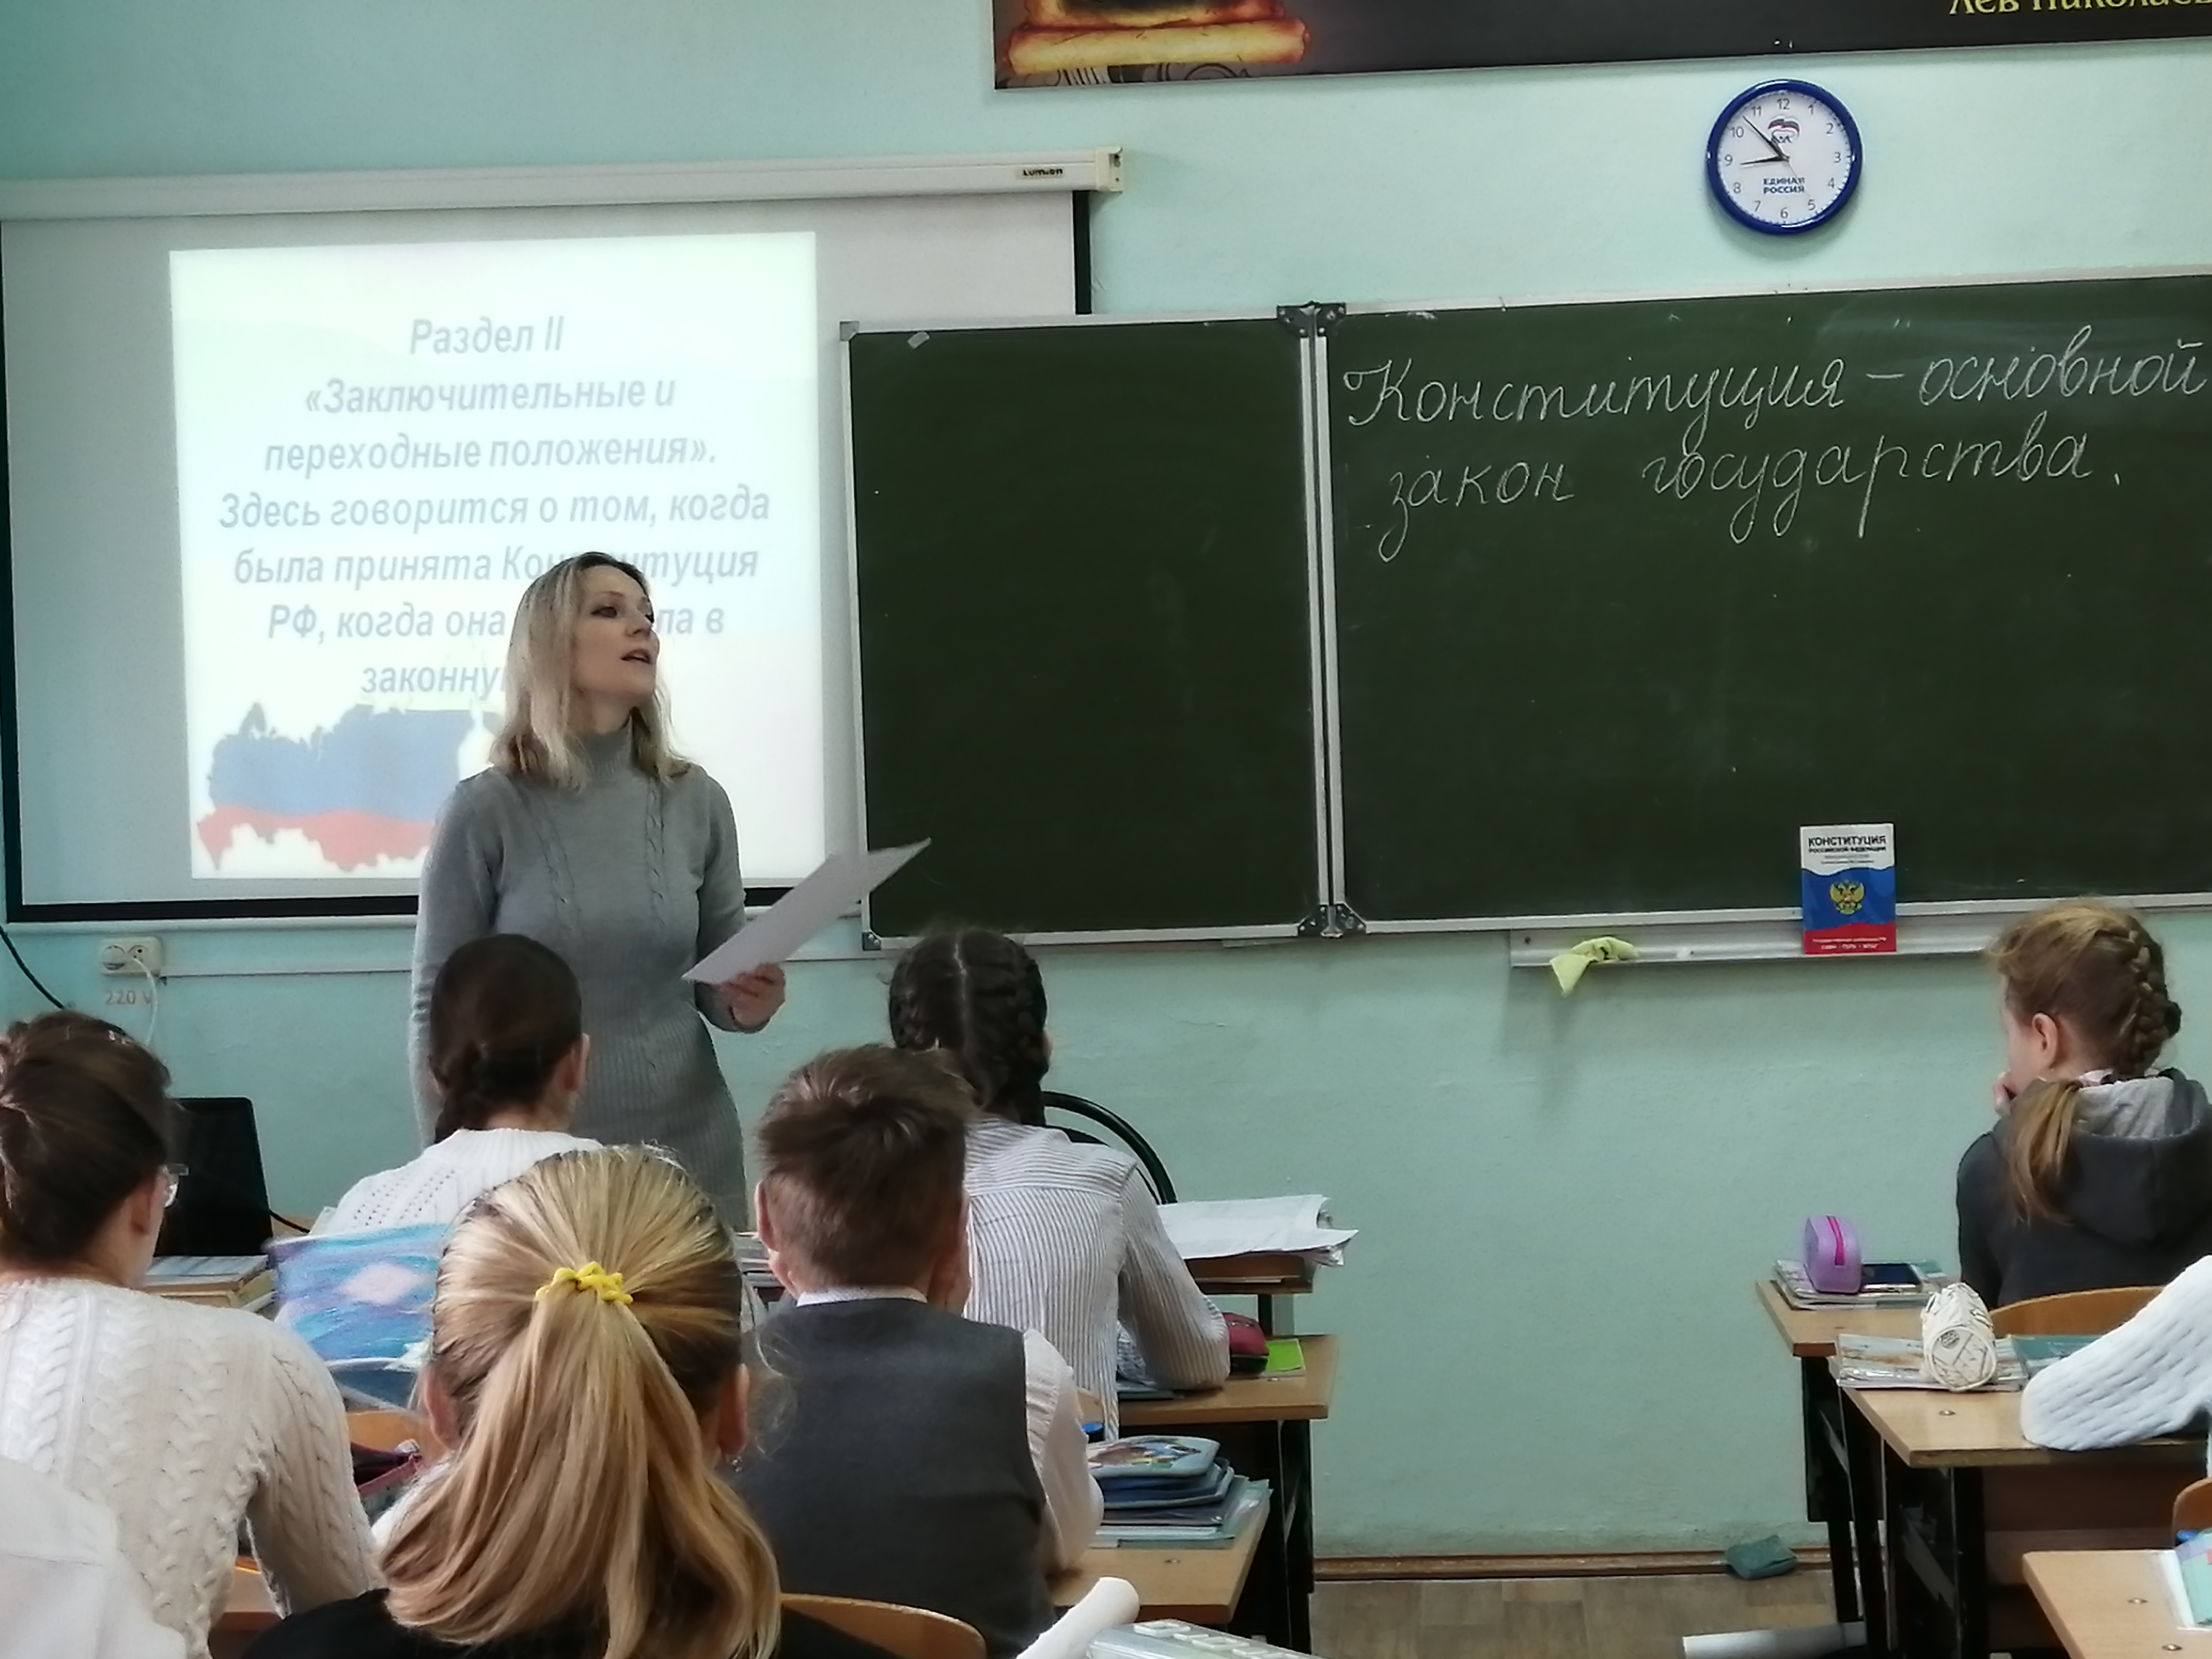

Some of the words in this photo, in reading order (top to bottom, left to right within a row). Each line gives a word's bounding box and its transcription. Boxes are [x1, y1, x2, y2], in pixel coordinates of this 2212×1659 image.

[1777, 98, 1789, 110] 12
[1808, 105, 1814, 115] 1
[1751, 106, 1762, 116] 11
[1730, 126, 1744, 138] 10
[1826, 123, 1834, 135] 2
[1724, 154, 1733, 167] 9
[1834, 152, 1841, 163] 3
[1733, 182, 1741, 194] 8
[1827, 178, 1835, 188] 4
[1754, 201, 1761, 212] 7
[1808, 199, 1816, 211] 5
[1780, 207, 1789, 219] 6
[410, 316, 534, 355] Раздел
[305, 377, 645, 413] «Заключительные
[655, 380, 675, 407] и
[1344, 357, 1845, 456] Конституция
[1920, 325, 2207, 406] основной
[265, 432, 481, 480] переходные
[489, 438, 715, 467] положения».
[219, 491, 321, 528] Здесь
[331, 497, 528, 534] говорится
[539, 497, 558, 523] о
[569, 496, 656, 528] том,
[669, 483, 769, 521] когда
[1379, 461, 1574, 562] закон
[234, 547, 324, 584] была
[334, 554, 491, 591] принята
[502, 546, 759, 587] Котуция
[268, 604, 324, 645] РФ,
[337, 601, 434, 638] когда
[445, 610, 506, 637] она
[706, 607, 725, 634] в
[1808, 836, 1886, 847] КОНСТИТУЦИЯ
[105, 990, 137, 1005] 220
